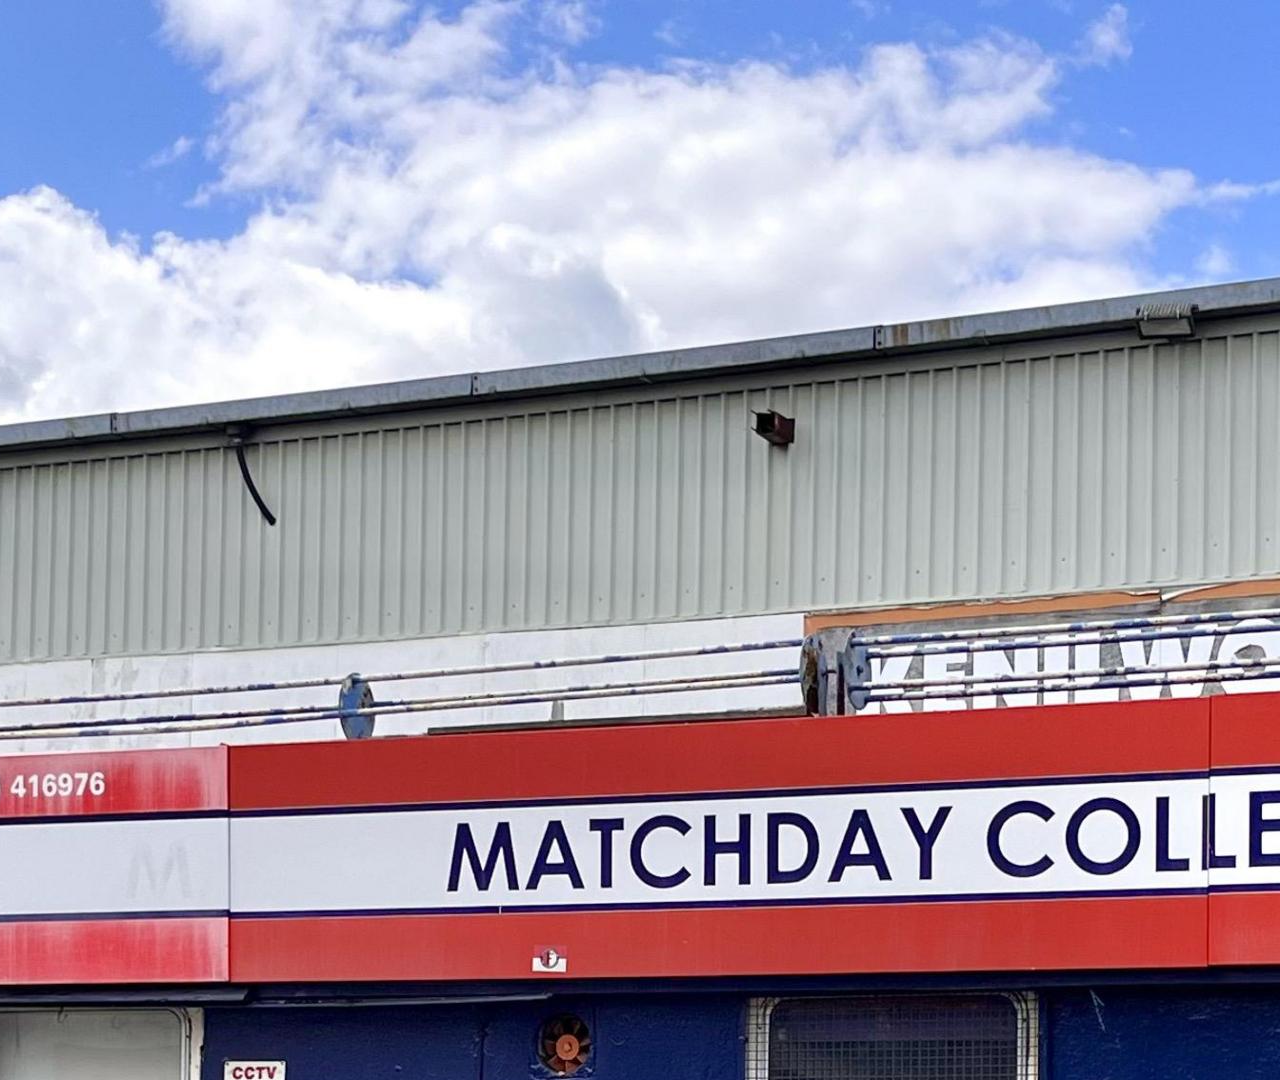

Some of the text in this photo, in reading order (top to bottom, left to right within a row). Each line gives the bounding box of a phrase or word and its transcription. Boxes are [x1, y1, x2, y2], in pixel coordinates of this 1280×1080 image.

[10, 771, 106, 798] 416976
[446, 805, 953, 893] MATCHDAY
[232, 1066, 277, 1080] CCTV
